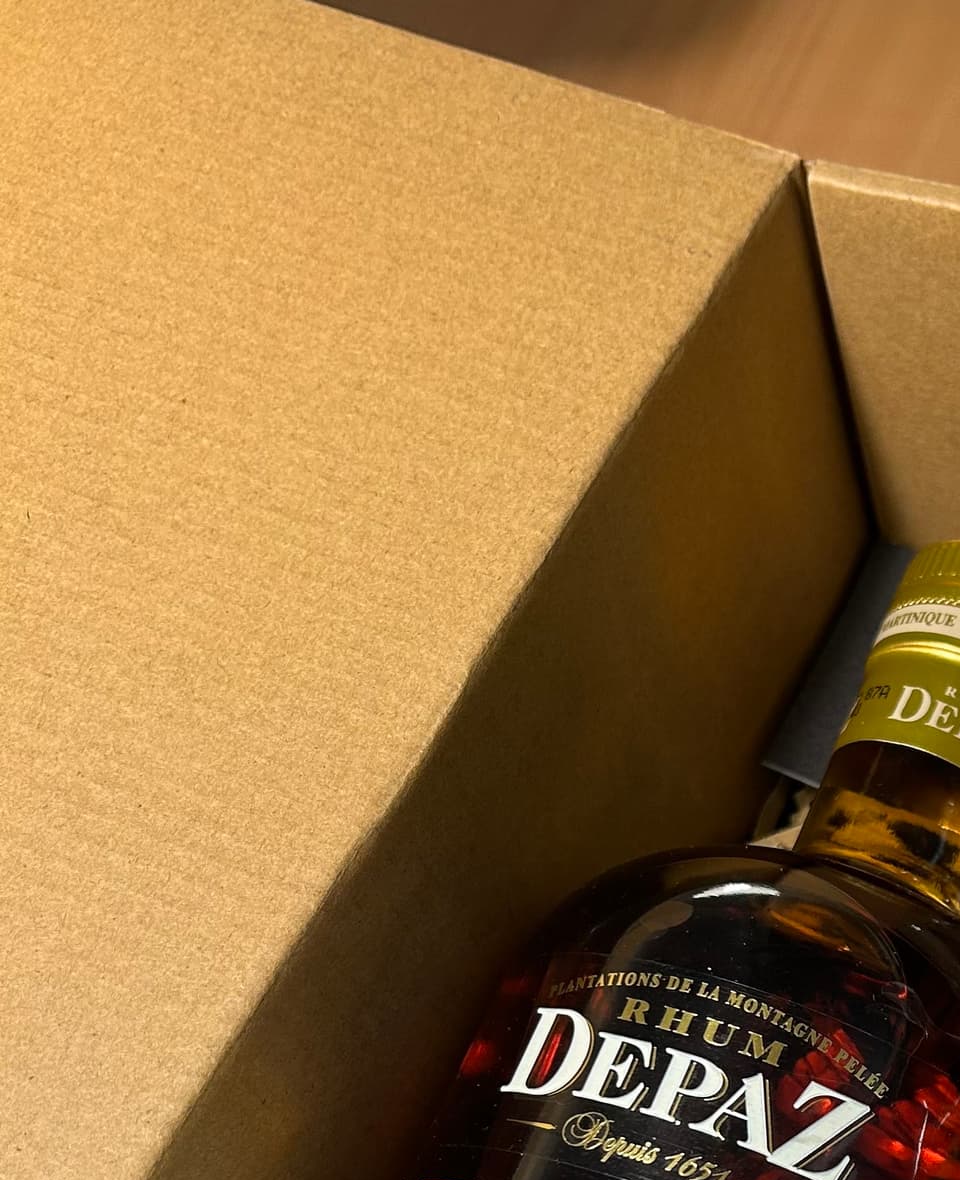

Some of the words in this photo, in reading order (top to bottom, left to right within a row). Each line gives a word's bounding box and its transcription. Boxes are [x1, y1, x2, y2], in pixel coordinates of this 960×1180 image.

[551, 971, 662, 999] PLANTATIONS
[665, 975, 693, 993] DE
[698, 981, 720, 1001] LA
[726, 990, 833, 1052] MONTAGNE
[836, 1048, 889, 1100] PELÉE
[617, 996, 788, 1068] RHUM
[561, 1111, 664, 1165] Depuis
